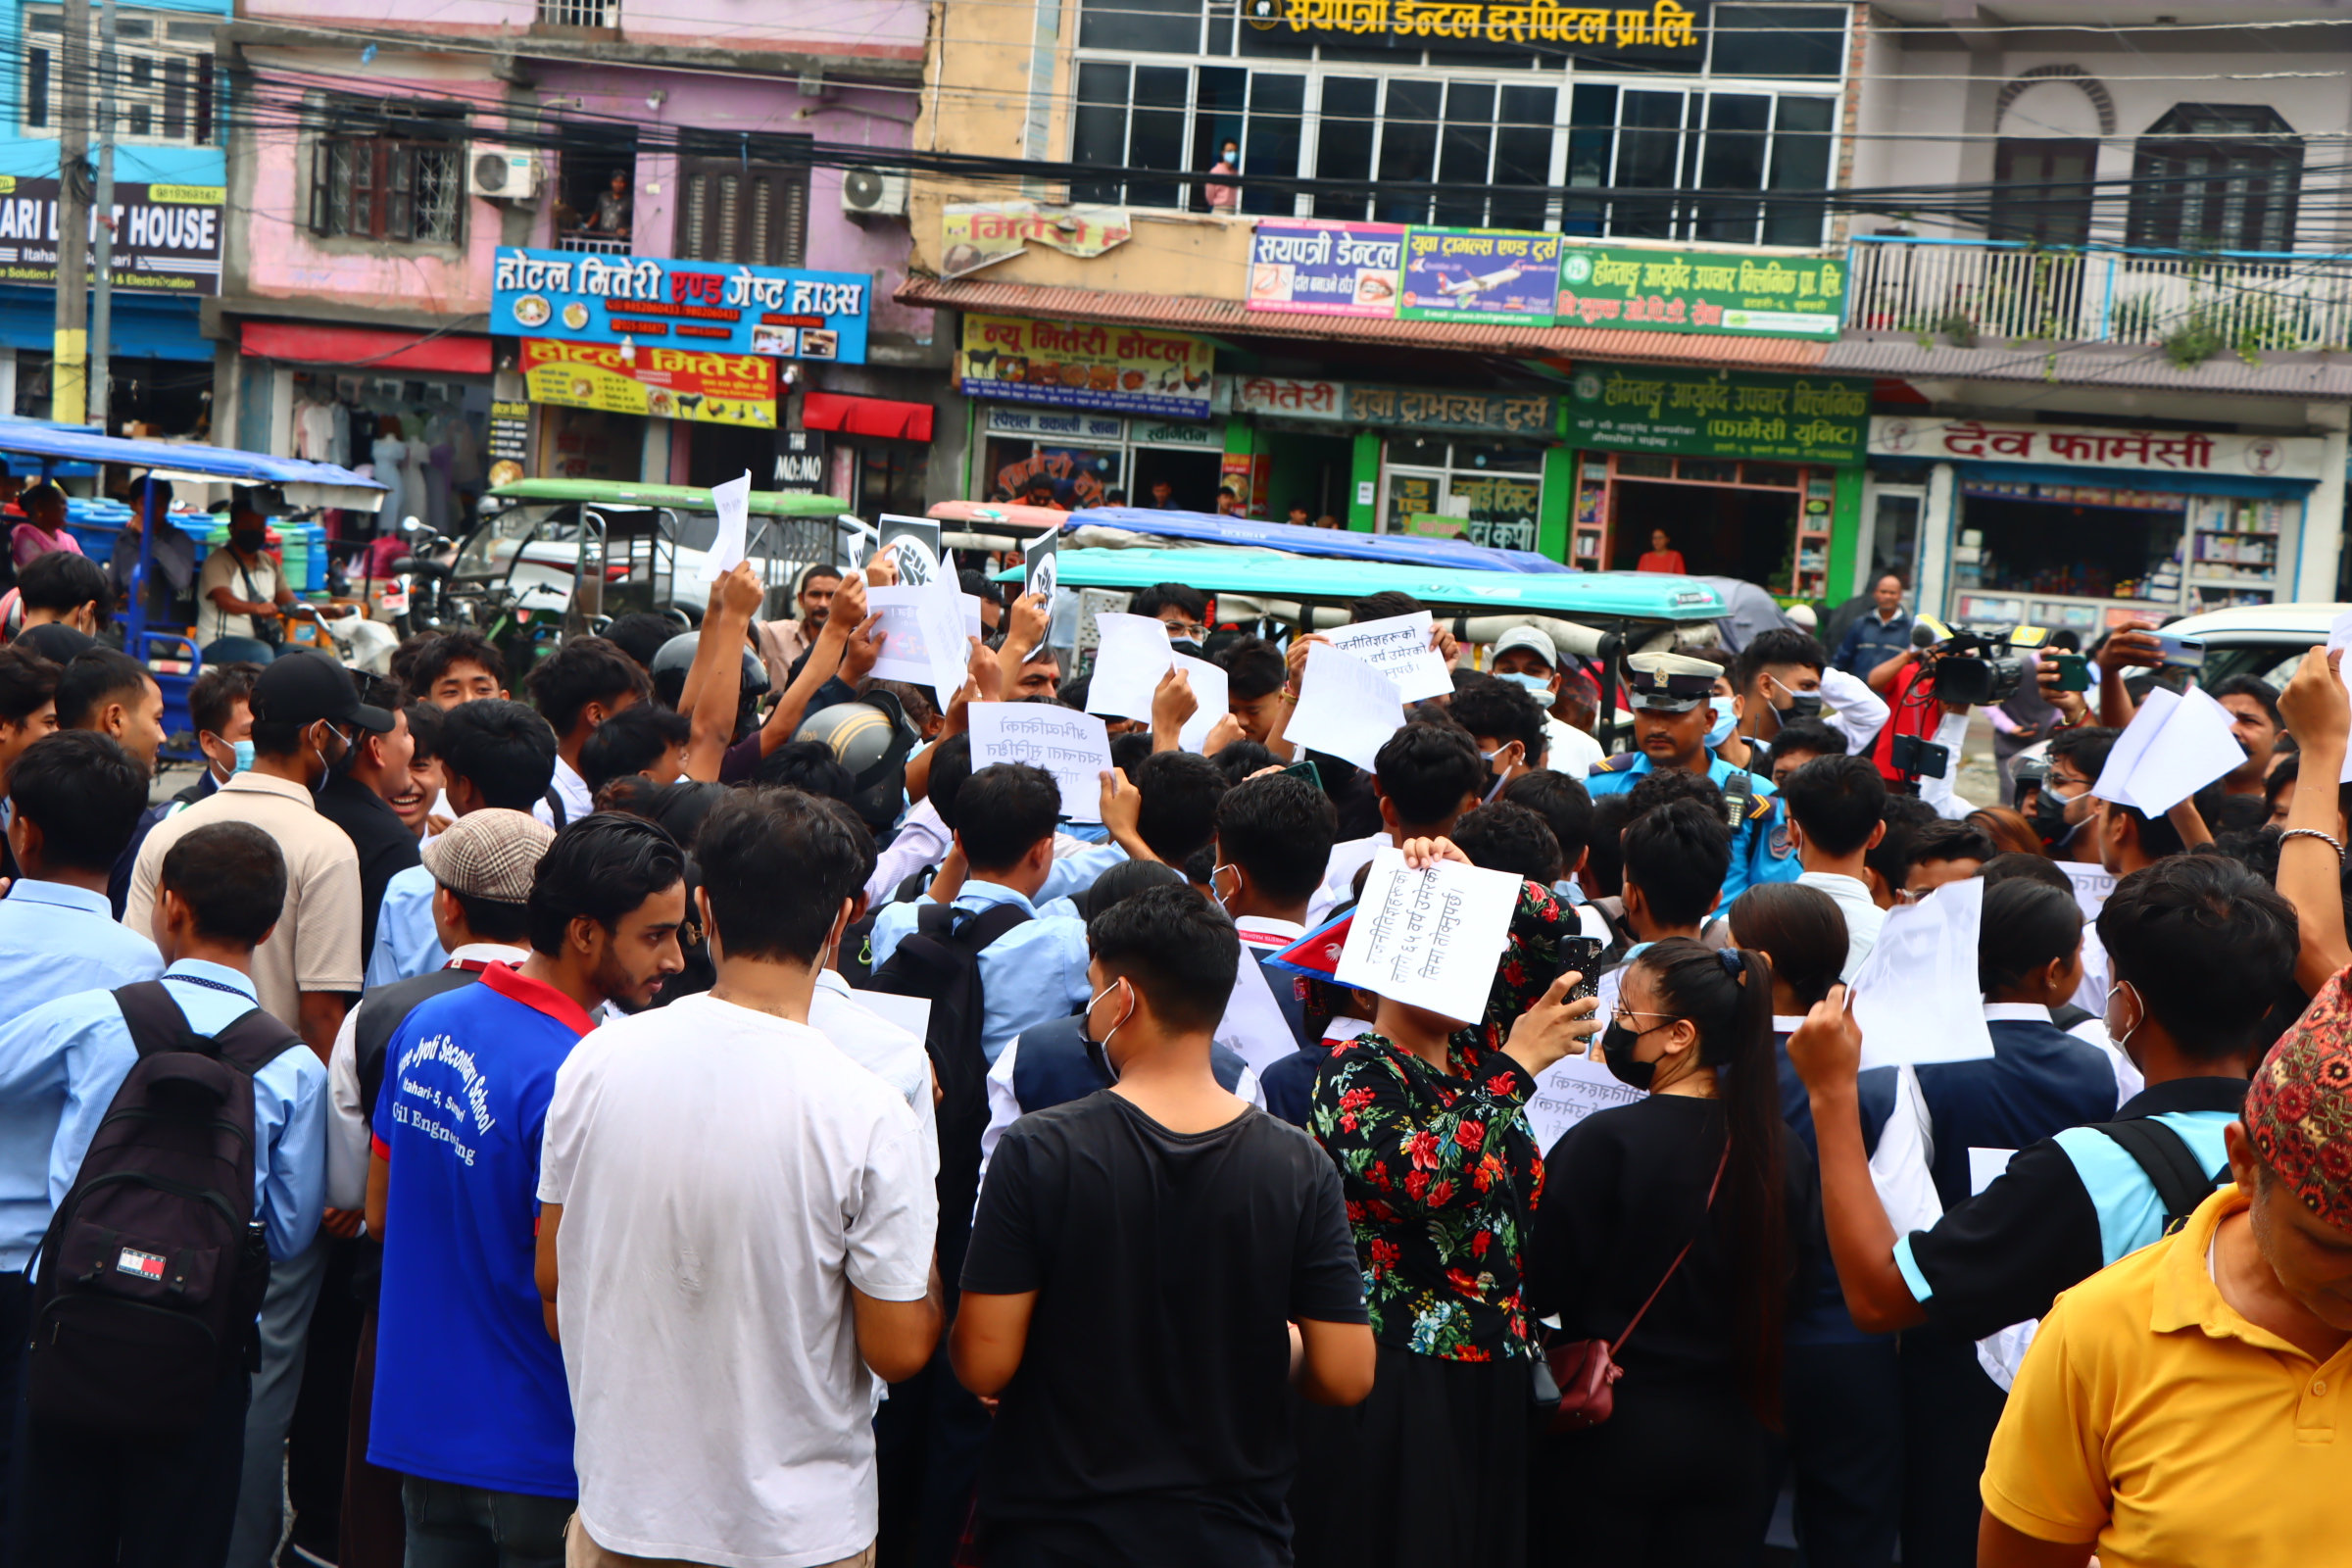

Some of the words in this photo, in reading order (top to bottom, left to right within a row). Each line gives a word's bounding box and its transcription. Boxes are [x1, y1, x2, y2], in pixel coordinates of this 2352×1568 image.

[128, 204, 217, 250] HOUSE
[497, 248, 572, 294] होटल
[578, 257, 662, 301] मितेरी
[651, 348, 771, 380] मितेरी
[1116, 329, 1193, 363] होटल
[1942, 420, 2035, 459] देव
[1389, 642, 1428, 661] उमेरको
[1405, 908, 1427, 931] वर्ष
[413, 1034, 442, 1068] Jyoti
[468, 1075, 496, 1137] School
